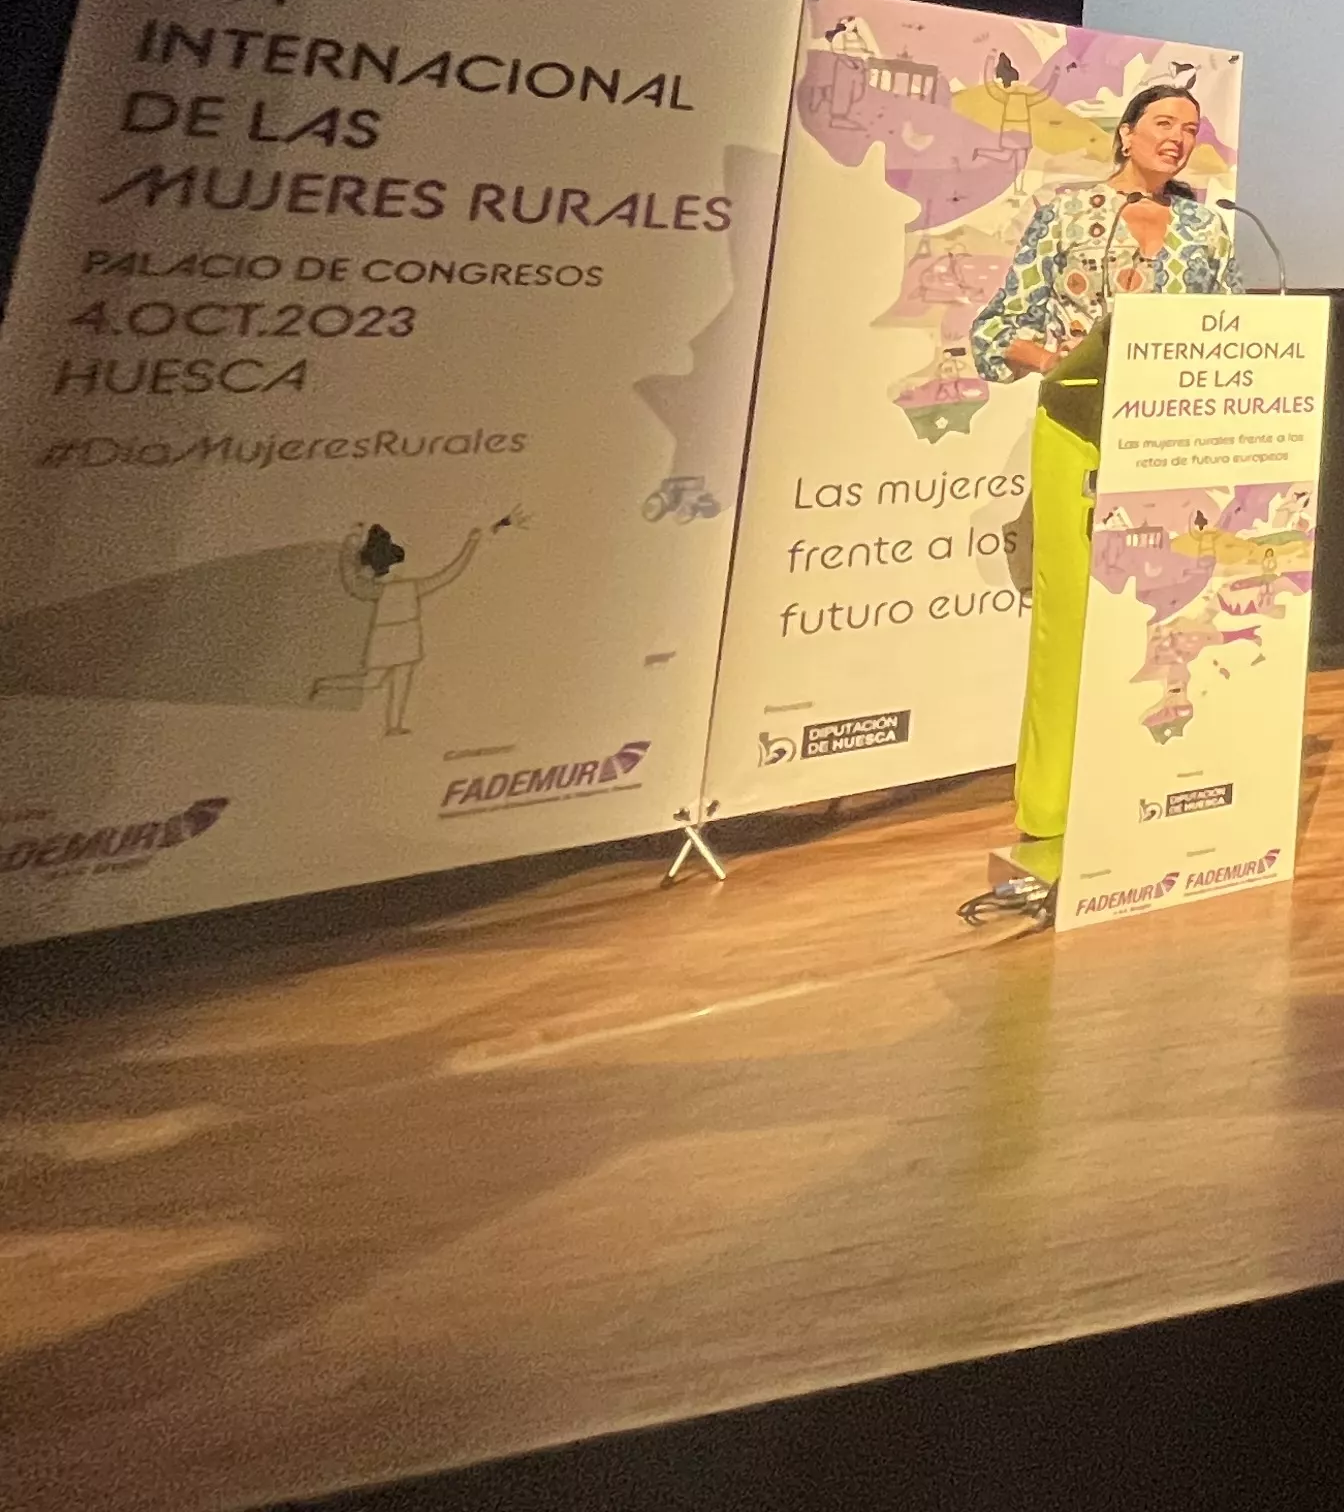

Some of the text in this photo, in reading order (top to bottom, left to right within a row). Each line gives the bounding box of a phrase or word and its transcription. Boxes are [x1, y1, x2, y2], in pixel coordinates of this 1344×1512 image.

[134, 19, 695, 111] INTERNACIONAL
[119, 91, 381, 149] DE LAS
[100, 165, 733, 232] MUJERES RURALES
[82, 249, 604, 287] PALACIO DE CONGRESOS
[70, 300, 416, 338] 4.OCT.2023
[1202, 310, 1240, 332] DÍA
[1127, 342, 1305, 360] INTERNACIONAL
[51, 358, 309, 394] HUESCA
[1179, 370, 1253, 388] DE LAS
[1113, 396, 1314, 419] MUJERES RURALES
[1143, 438, 1190, 451] mujeres
[1192, 454, 1230, 465] futuro
[795, 471, 1026, 509] Las mujeres
[787, 527, 1018, 573] frente a los
[780, 600, 914, 637] futuro
[832, 730, 896, 751] HUESCA
[441, 760, 599, 807] FADEMUR
[1075, 884, 1154, 917] FADEMUR
[1185, 860, 1256, 890] FADEMUR
